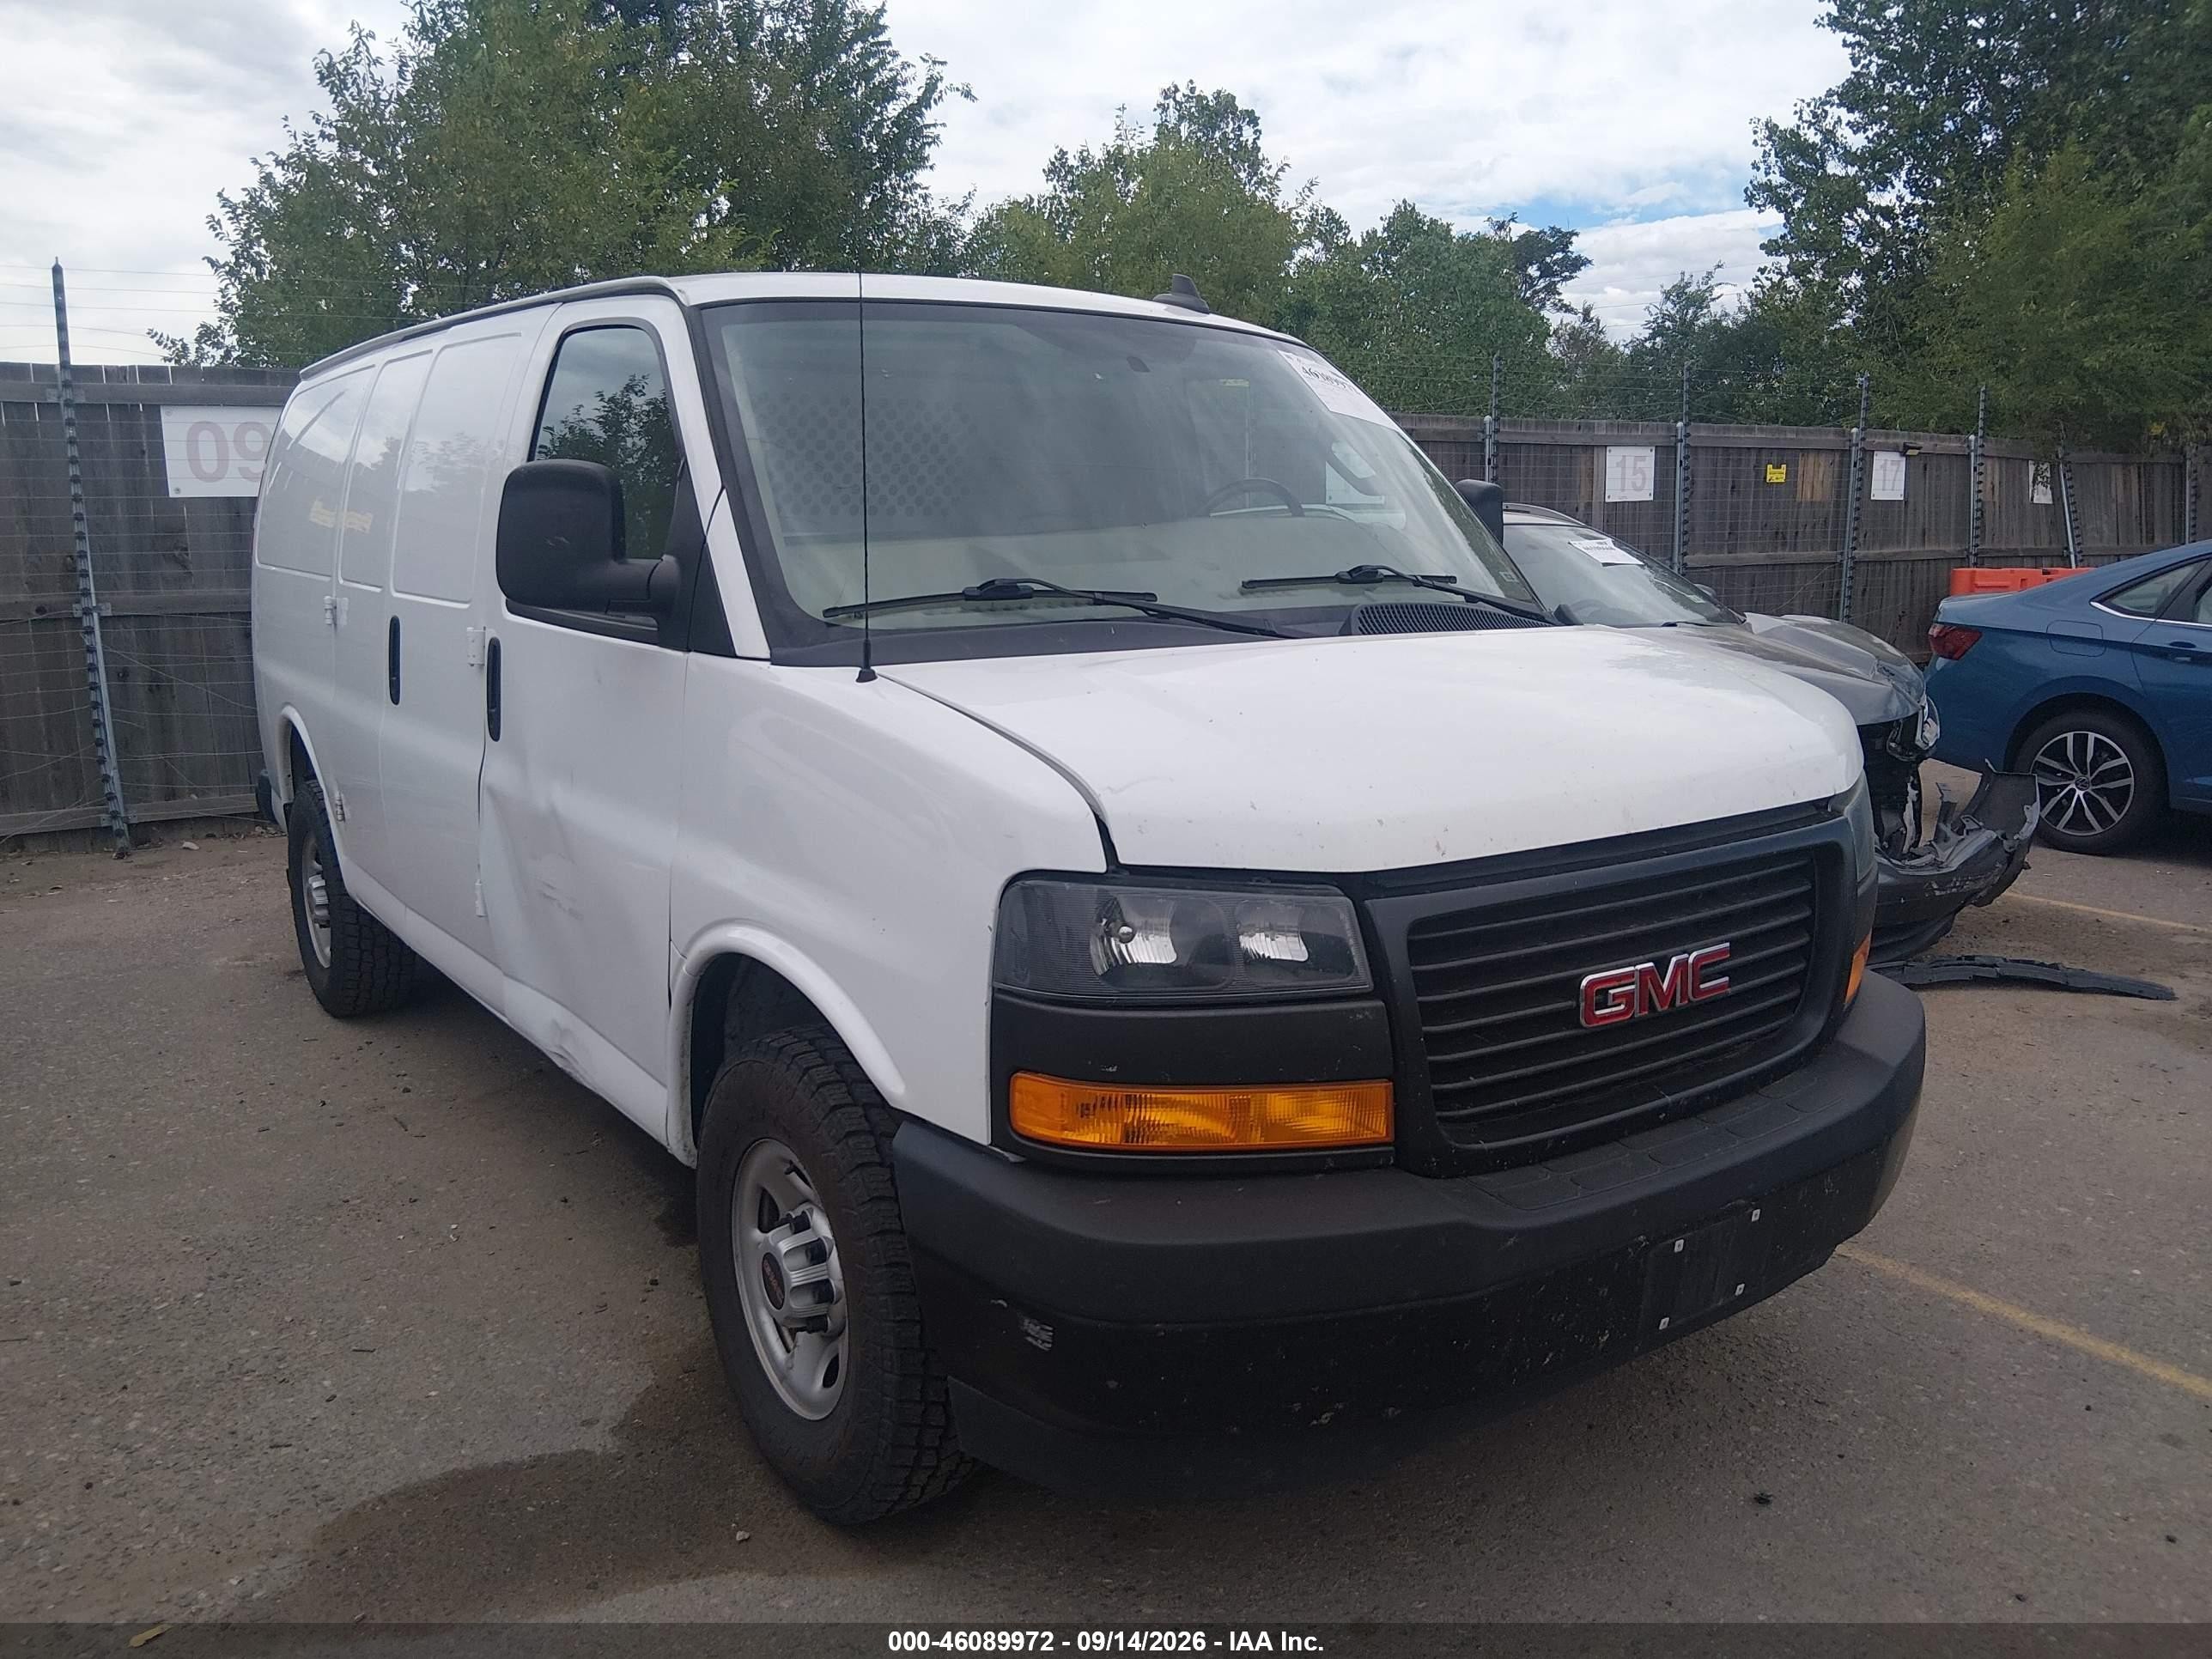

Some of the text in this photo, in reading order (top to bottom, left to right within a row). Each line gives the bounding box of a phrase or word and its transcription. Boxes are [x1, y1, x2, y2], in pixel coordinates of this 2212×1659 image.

[186, 421, 272, 483] 09
[1615, 454, 1646, 492] 15
[1881, 459, 1901, 491] 17
[1580, 942, 1730, 1028] GMC
